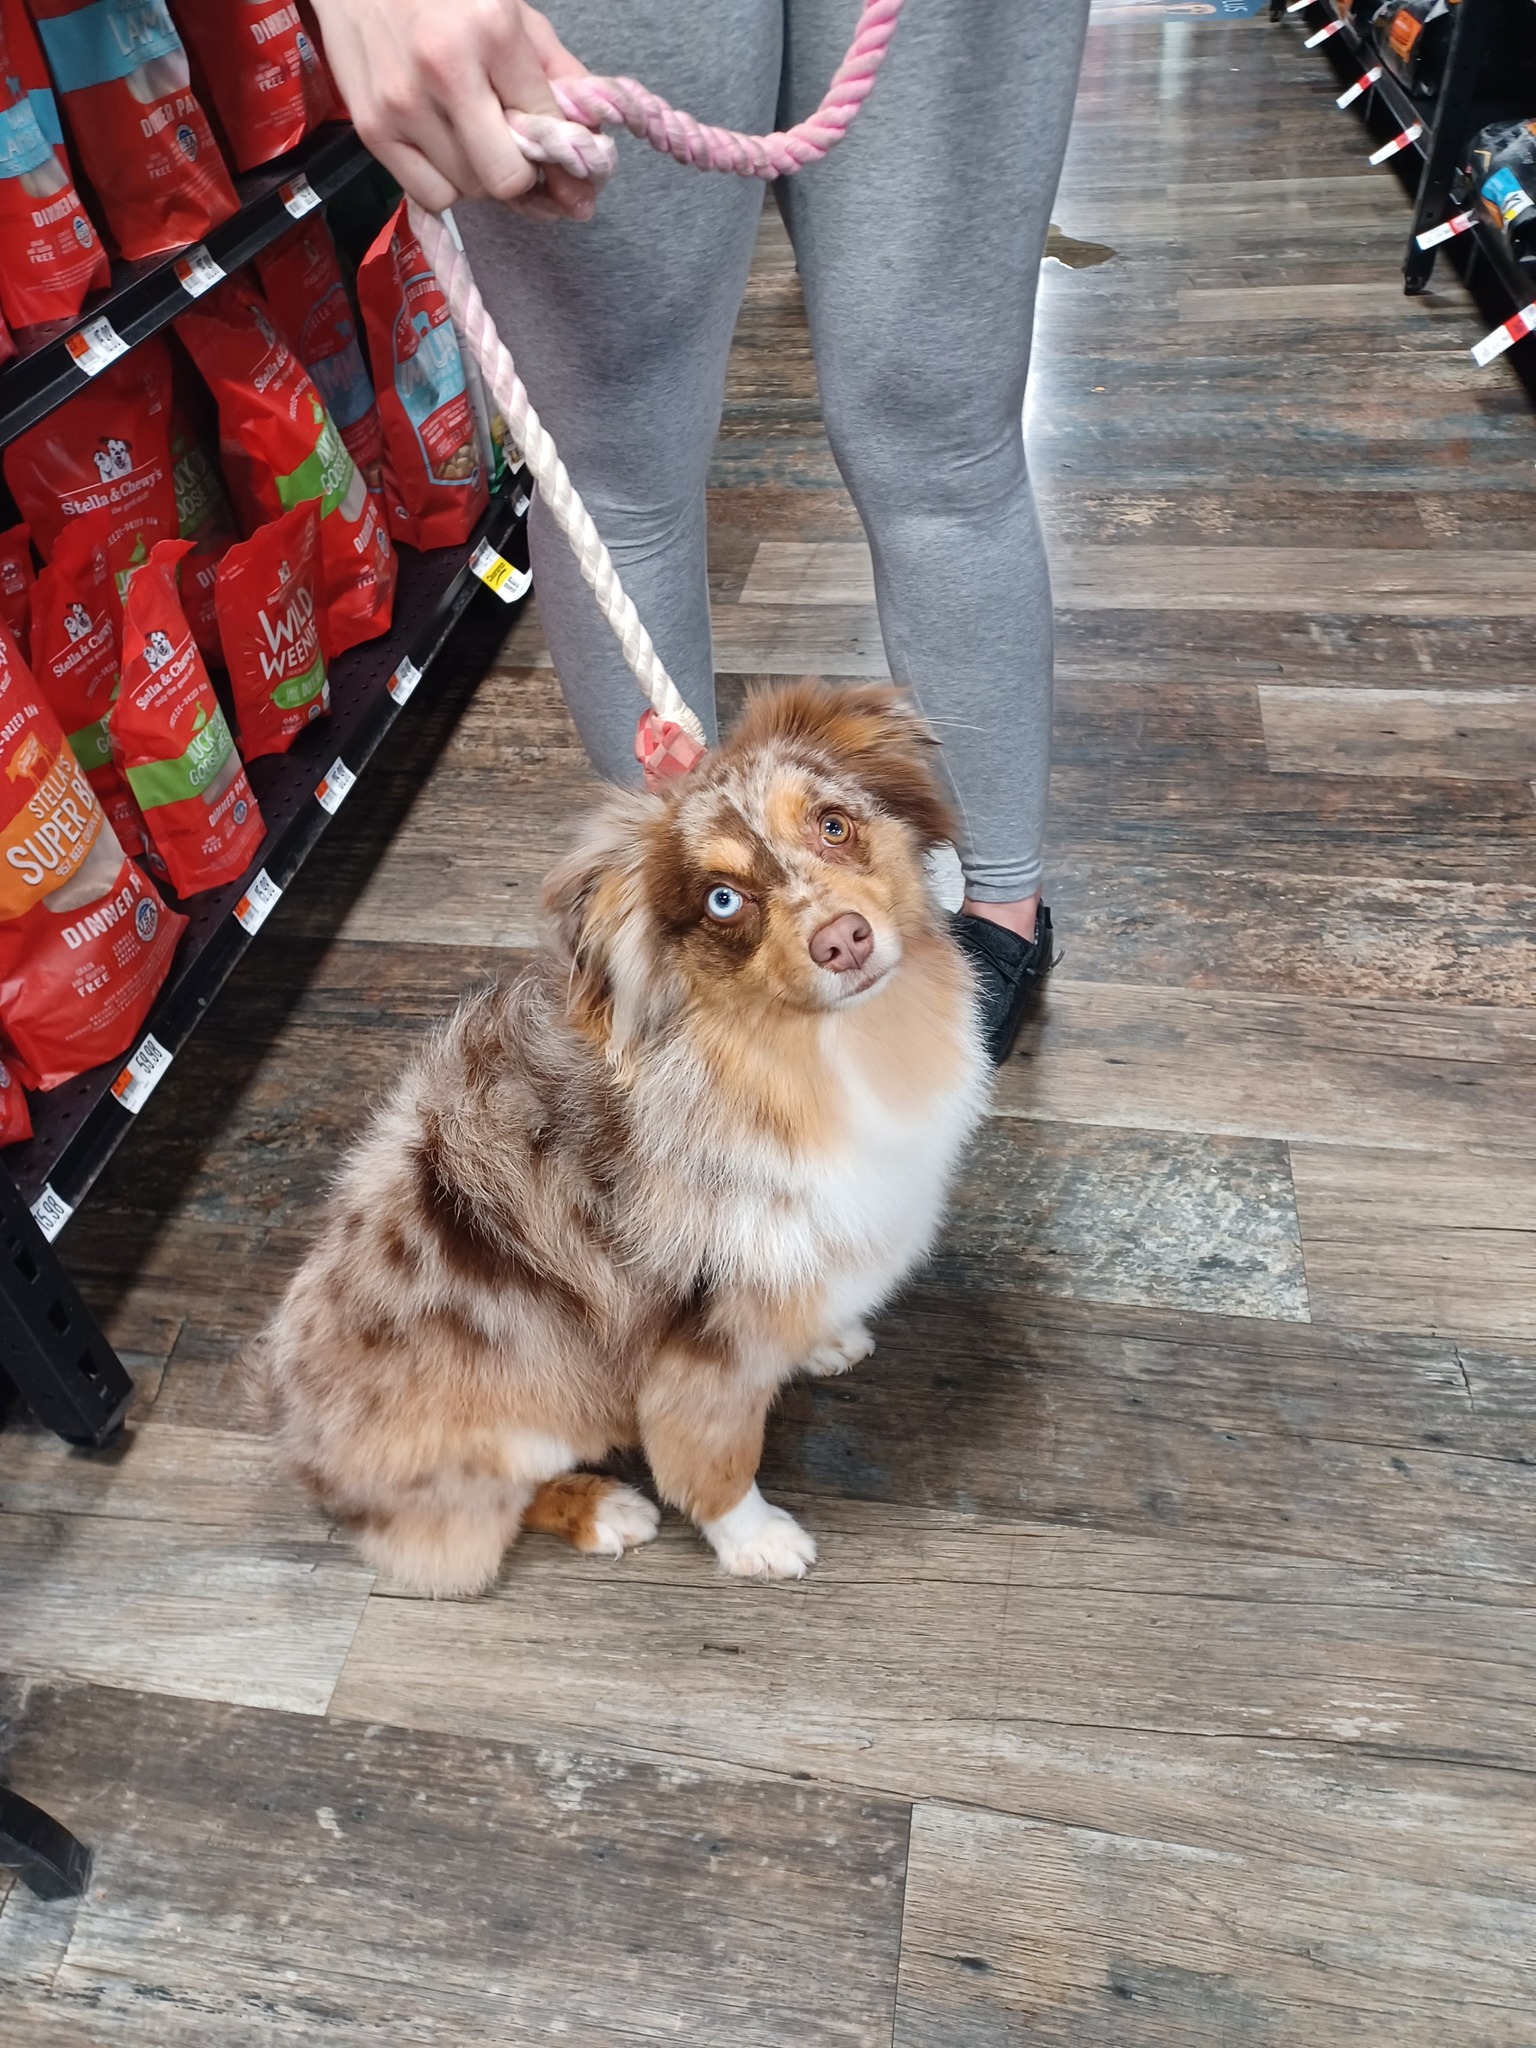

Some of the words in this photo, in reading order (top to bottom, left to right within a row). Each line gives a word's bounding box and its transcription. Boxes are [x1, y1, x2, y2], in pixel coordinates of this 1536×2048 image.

[149, 164, 172, 179] FREE
[30, 251, 56, 264] FREE
[254, 363, 280, 393] Stella
[61, 493, 110, 515] Stella
[110, 487, 122, 502] &
[258, 586, 314, 654] WILD
[53, 652, 83, 678] Stella
[79, 644, 90, 657] &
[136, 684, 163, 711] Stella
[160, 673, 173, 687] &
[28, 755, 72, 820] STELLA'S
[208, 790, 236, 828] DINNER
[6, 798, 87, 885] SUPER
[61, 887, 134, 950] DINNER
[138, 907, 156, 933] USA
[77, 972, 110, 998] FREE
[135, 1040, 163, 1074] 59.98
[33, 1195, 65, 1231] 15.98
